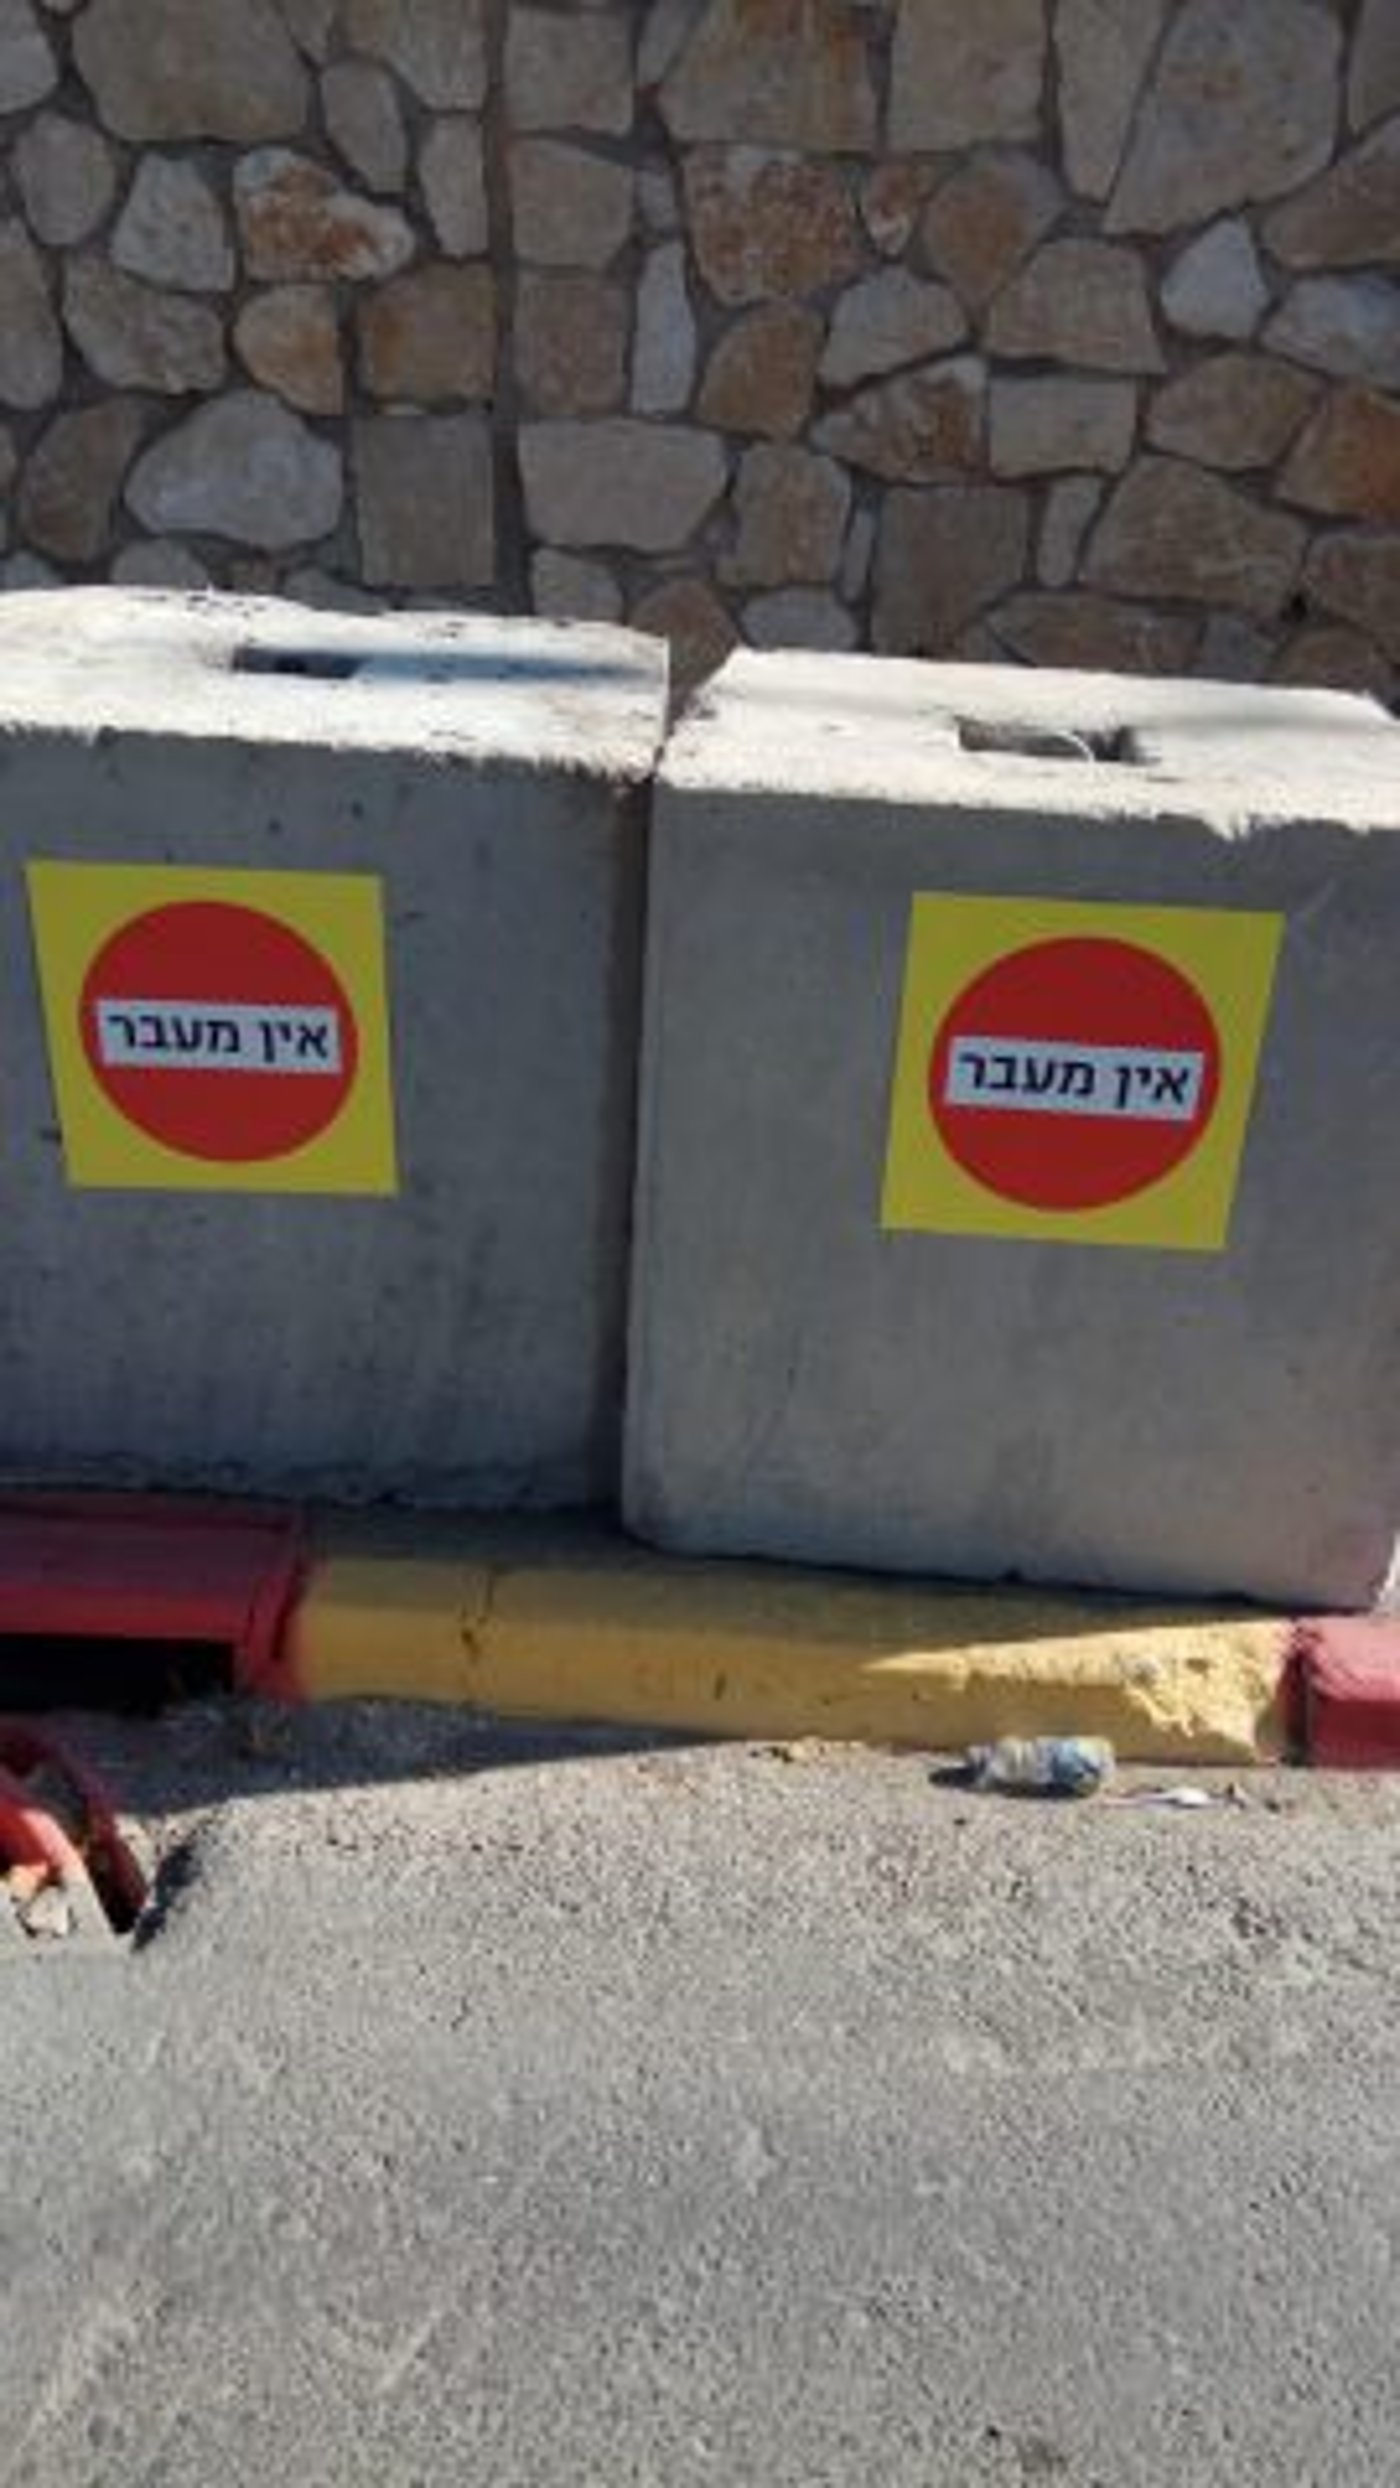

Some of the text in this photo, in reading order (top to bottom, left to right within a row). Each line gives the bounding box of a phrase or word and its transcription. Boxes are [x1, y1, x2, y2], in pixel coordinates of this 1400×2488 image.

[107, 1014, 328, 1064] אין מעבר
[959, 1052, 1189, 1109] אין מעבר
